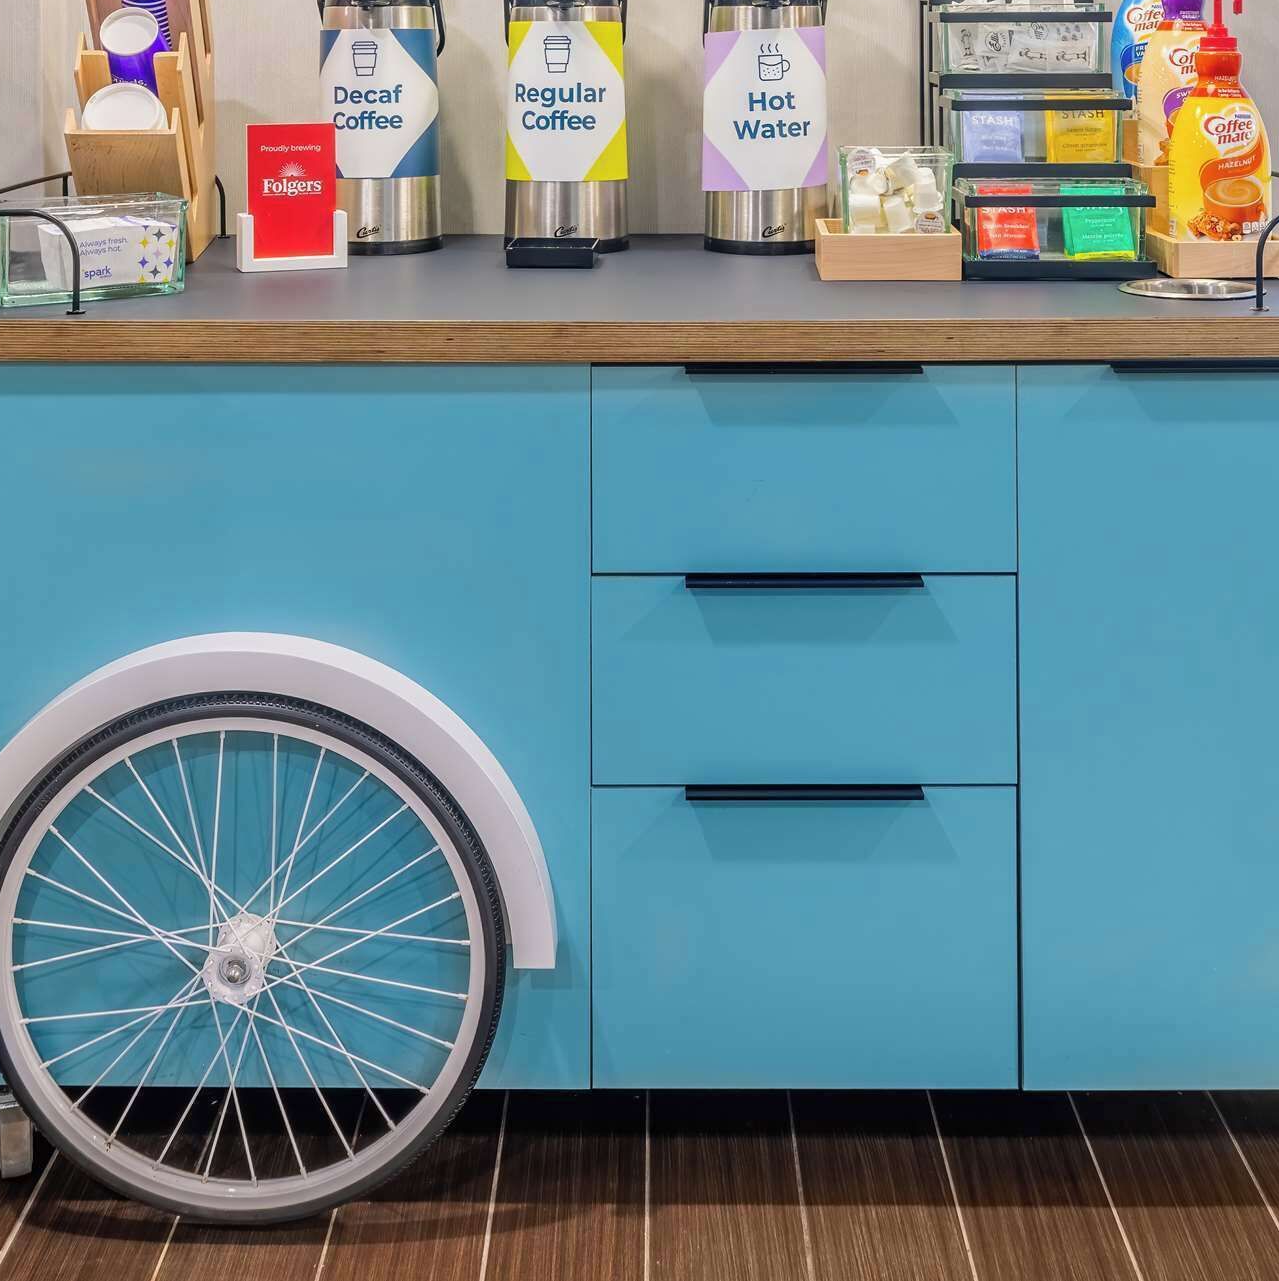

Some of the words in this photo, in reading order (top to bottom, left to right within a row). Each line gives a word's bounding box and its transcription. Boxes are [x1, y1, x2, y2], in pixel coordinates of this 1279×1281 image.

[1134, 20, 1160, 32] mat
[334, 84, 403, 104] Decaf
[515, 82, 606, 108] Regular
[748, 91, 796, 111] Hot
[333, 110, 403, 130] Coffee
[522, 110, 596, 130] Coffee
[971, 115, 1013, 126] STASH
[1062, 109, 1104, 119] STASH
[733, 119, 810, 140] Water
[1204, 115, 1253, 136] Coffee
[1217, 129, 1253, 145] mate
[260, 145, 290, 153] Proudly
[290, 144, 321, 152] brewing
[1218, 156, 1256, 170] HAZELNUT
[262, 178, 322, 196] Folgers
[79, 238, 106, 249] Always
[107, 236, 128, 244] fresh.
[79, 247, 106, 257] Always
[84, 266, 111, 280] spark
